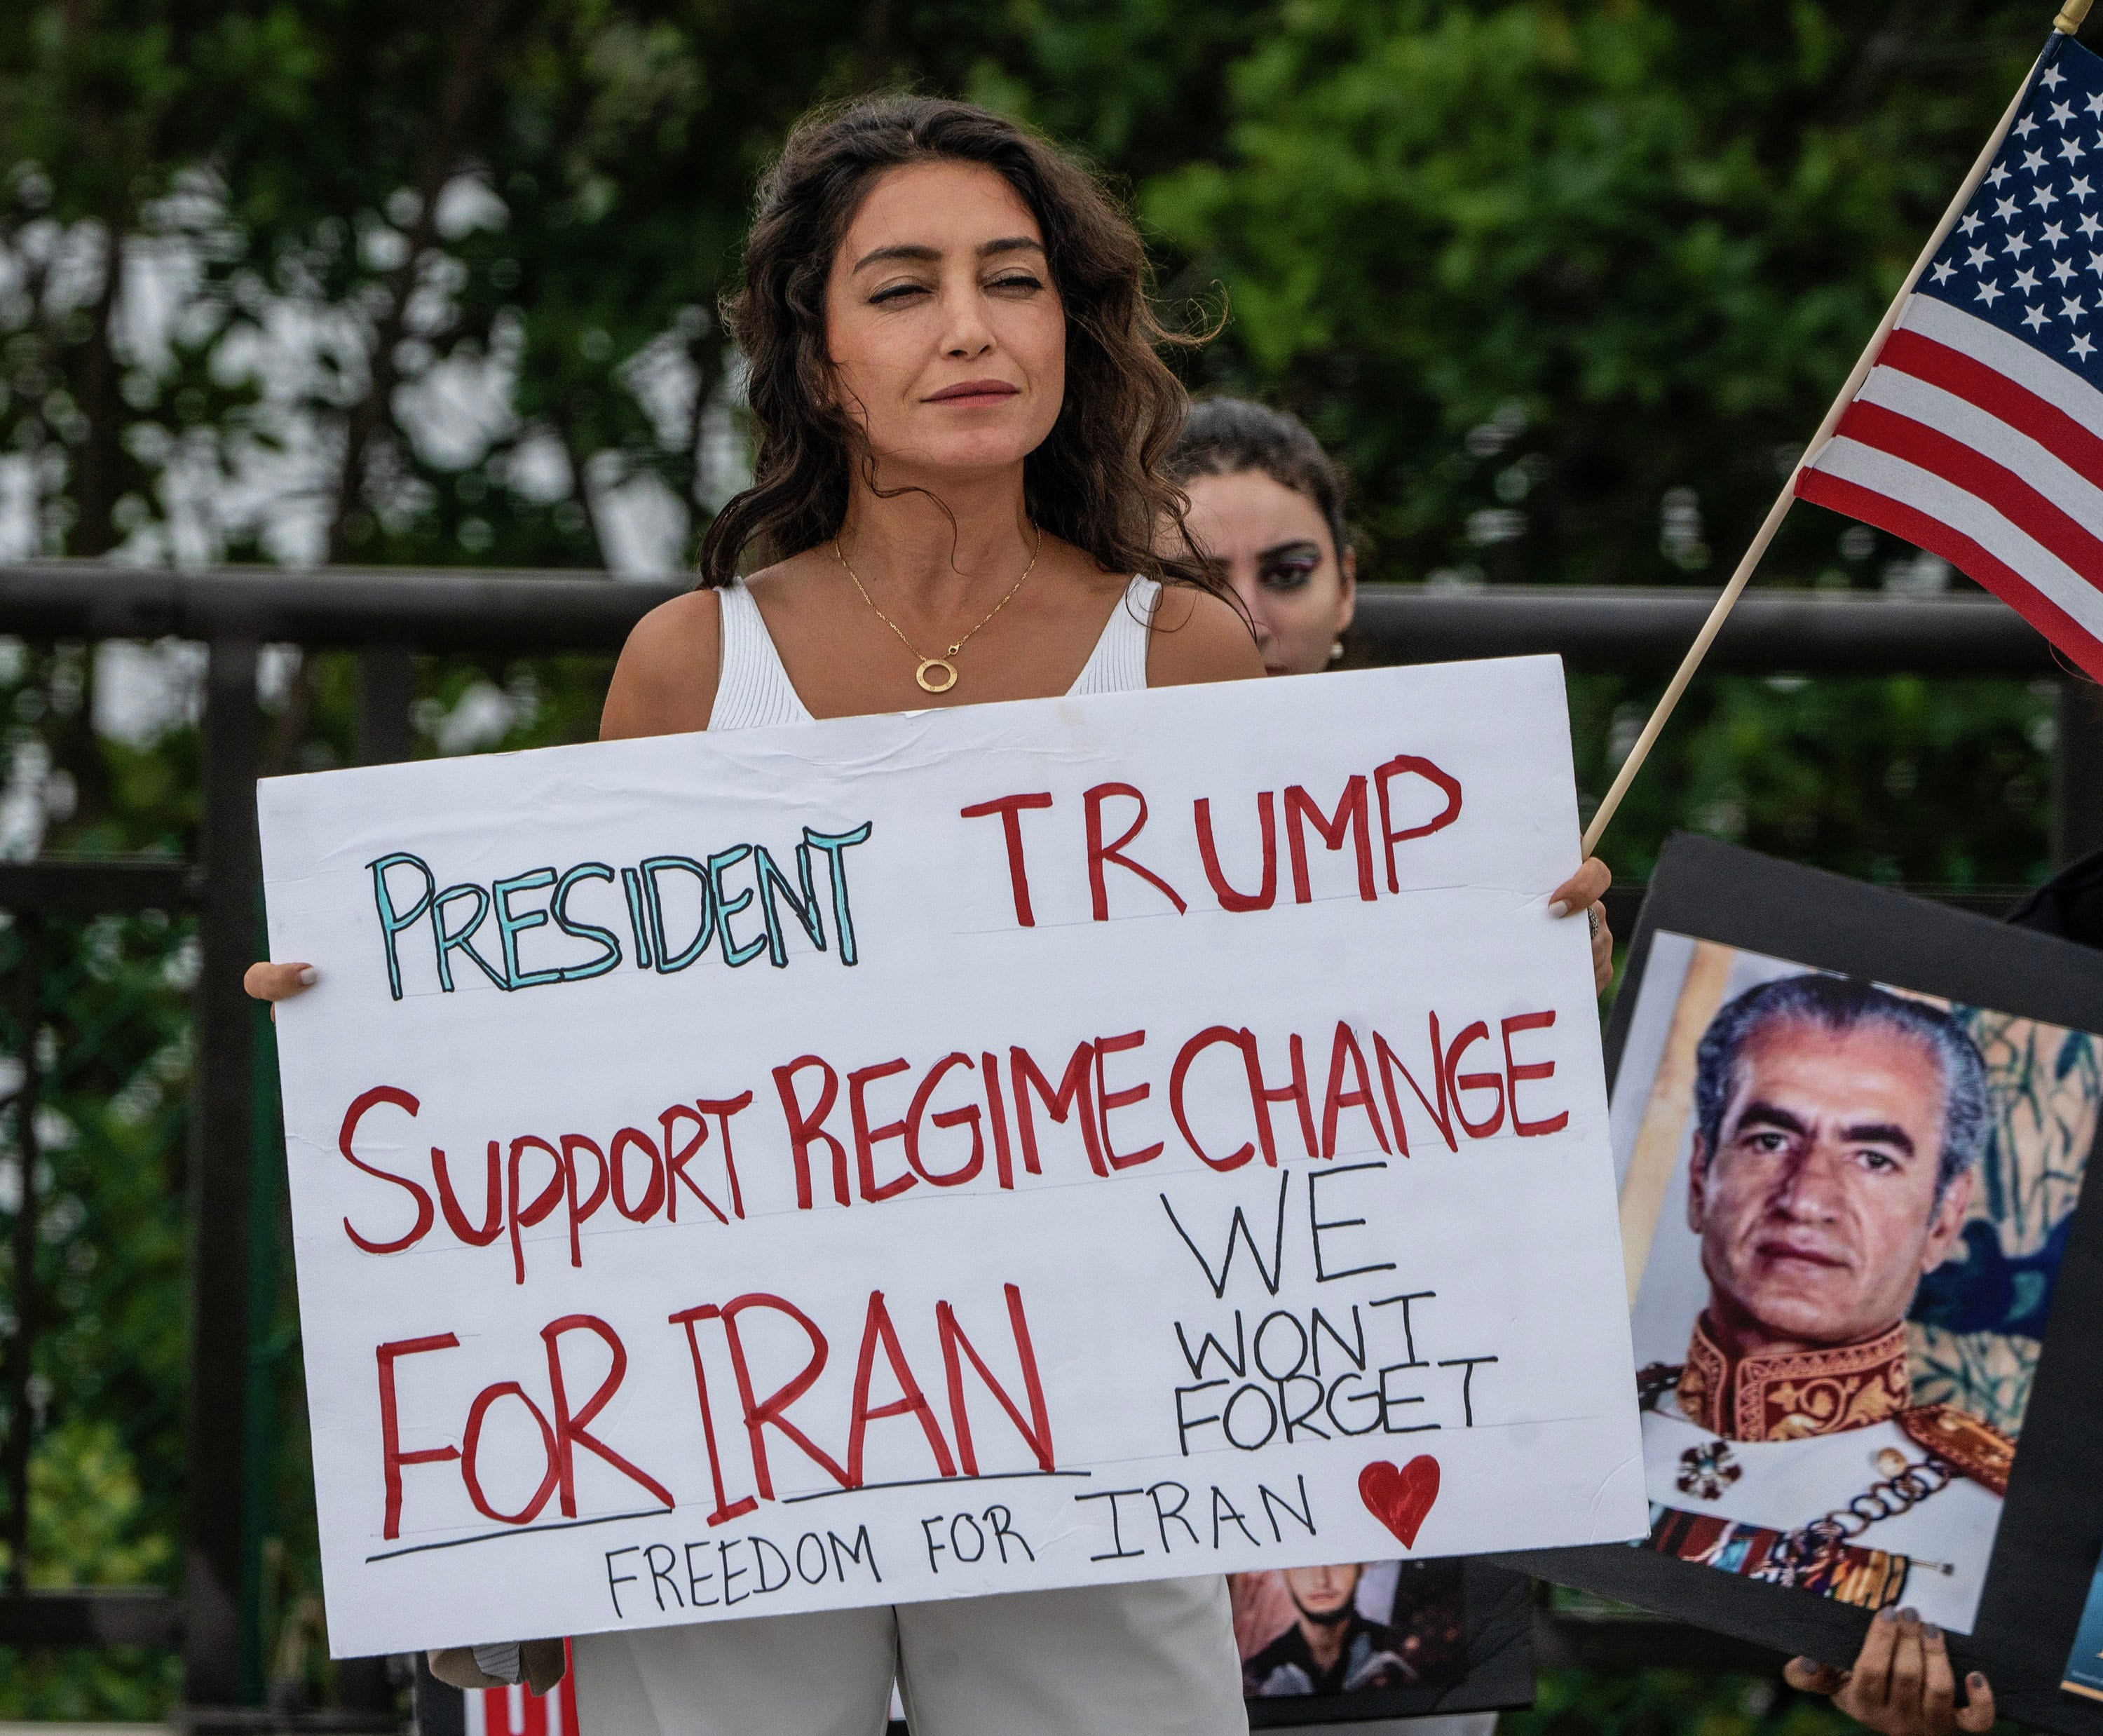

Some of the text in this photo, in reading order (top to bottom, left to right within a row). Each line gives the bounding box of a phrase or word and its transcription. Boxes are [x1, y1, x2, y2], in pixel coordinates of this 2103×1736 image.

[365, 754, 1463, 1001] PRESIDENT TRUMP
[771, 1031, 1165, 1210] REGIME
[1169, 1010, 1570, 1172] CHANGE
[1159, 1162, 1417, 1299] WE
[1173, 1290, 1437, 1382] WONT
[1173, 1355, 1499, 1458] FORGET
[376, 1283, 1056, 1540] FOR IRAN
[604, 1473, 1318, 1620] FREEDOM FOR IRAN
